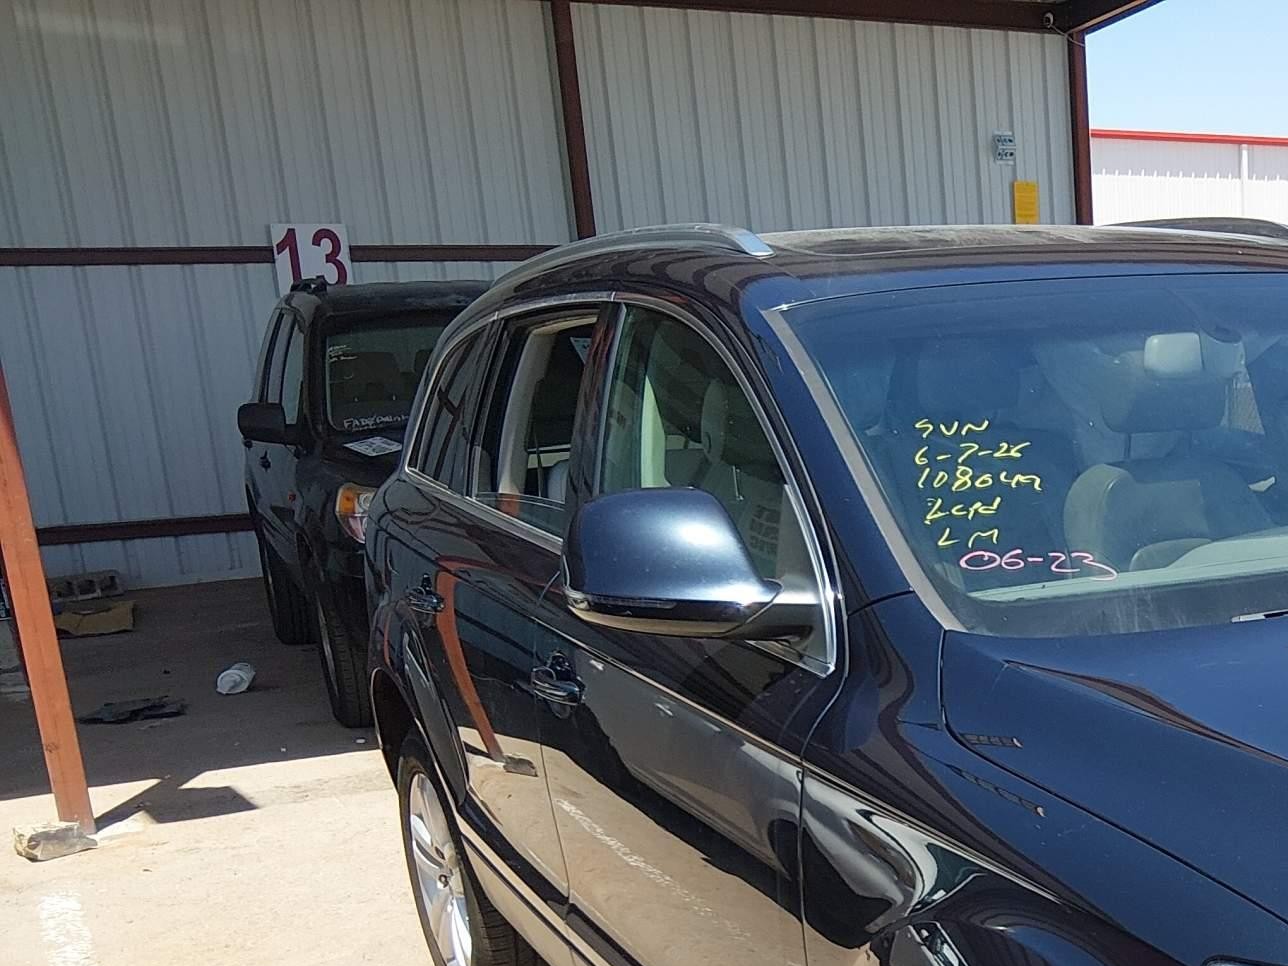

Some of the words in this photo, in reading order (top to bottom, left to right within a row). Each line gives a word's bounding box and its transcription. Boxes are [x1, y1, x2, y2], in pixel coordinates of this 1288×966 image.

[275, 227, 348, 286] 13
[914, 418, 989, 438] SUN
[959, 549, 1118, 581] 06-23
